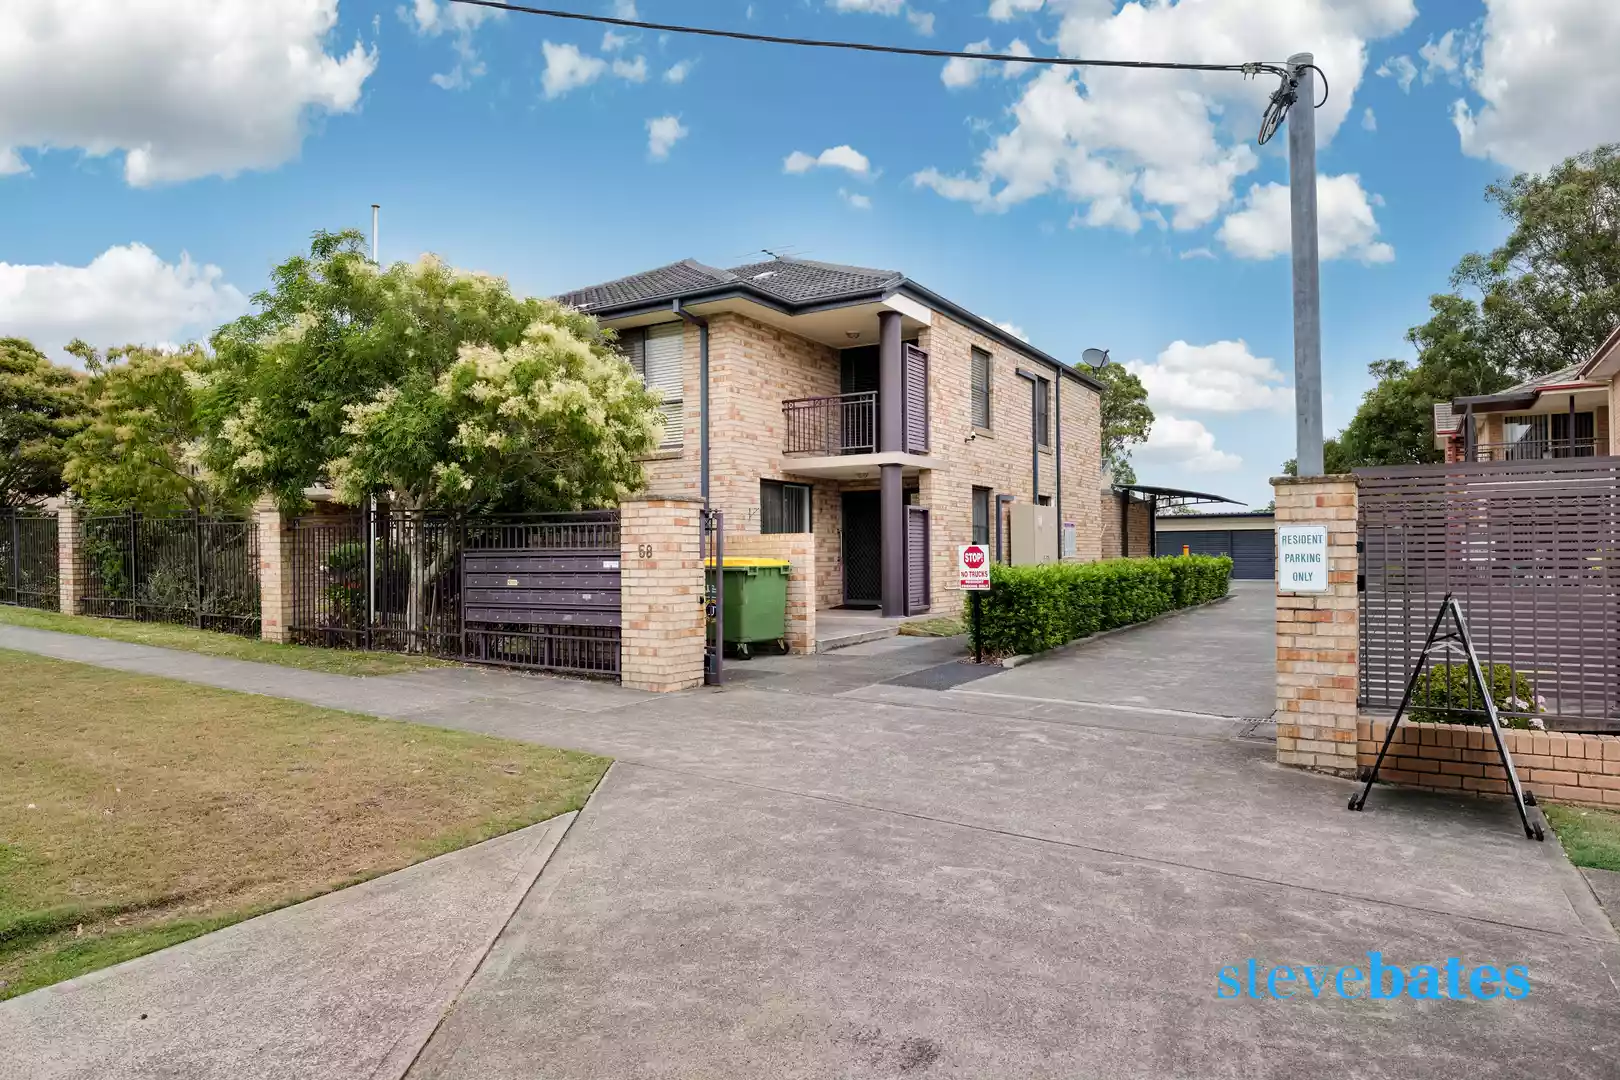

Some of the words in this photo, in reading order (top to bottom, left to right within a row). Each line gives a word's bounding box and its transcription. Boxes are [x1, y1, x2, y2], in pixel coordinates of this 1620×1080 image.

[1282, 534, 1323, 545] RESIDENT
[1285, 553, 1321, 563] PARKING
[1292, 571, 1313, 581] ONLY
